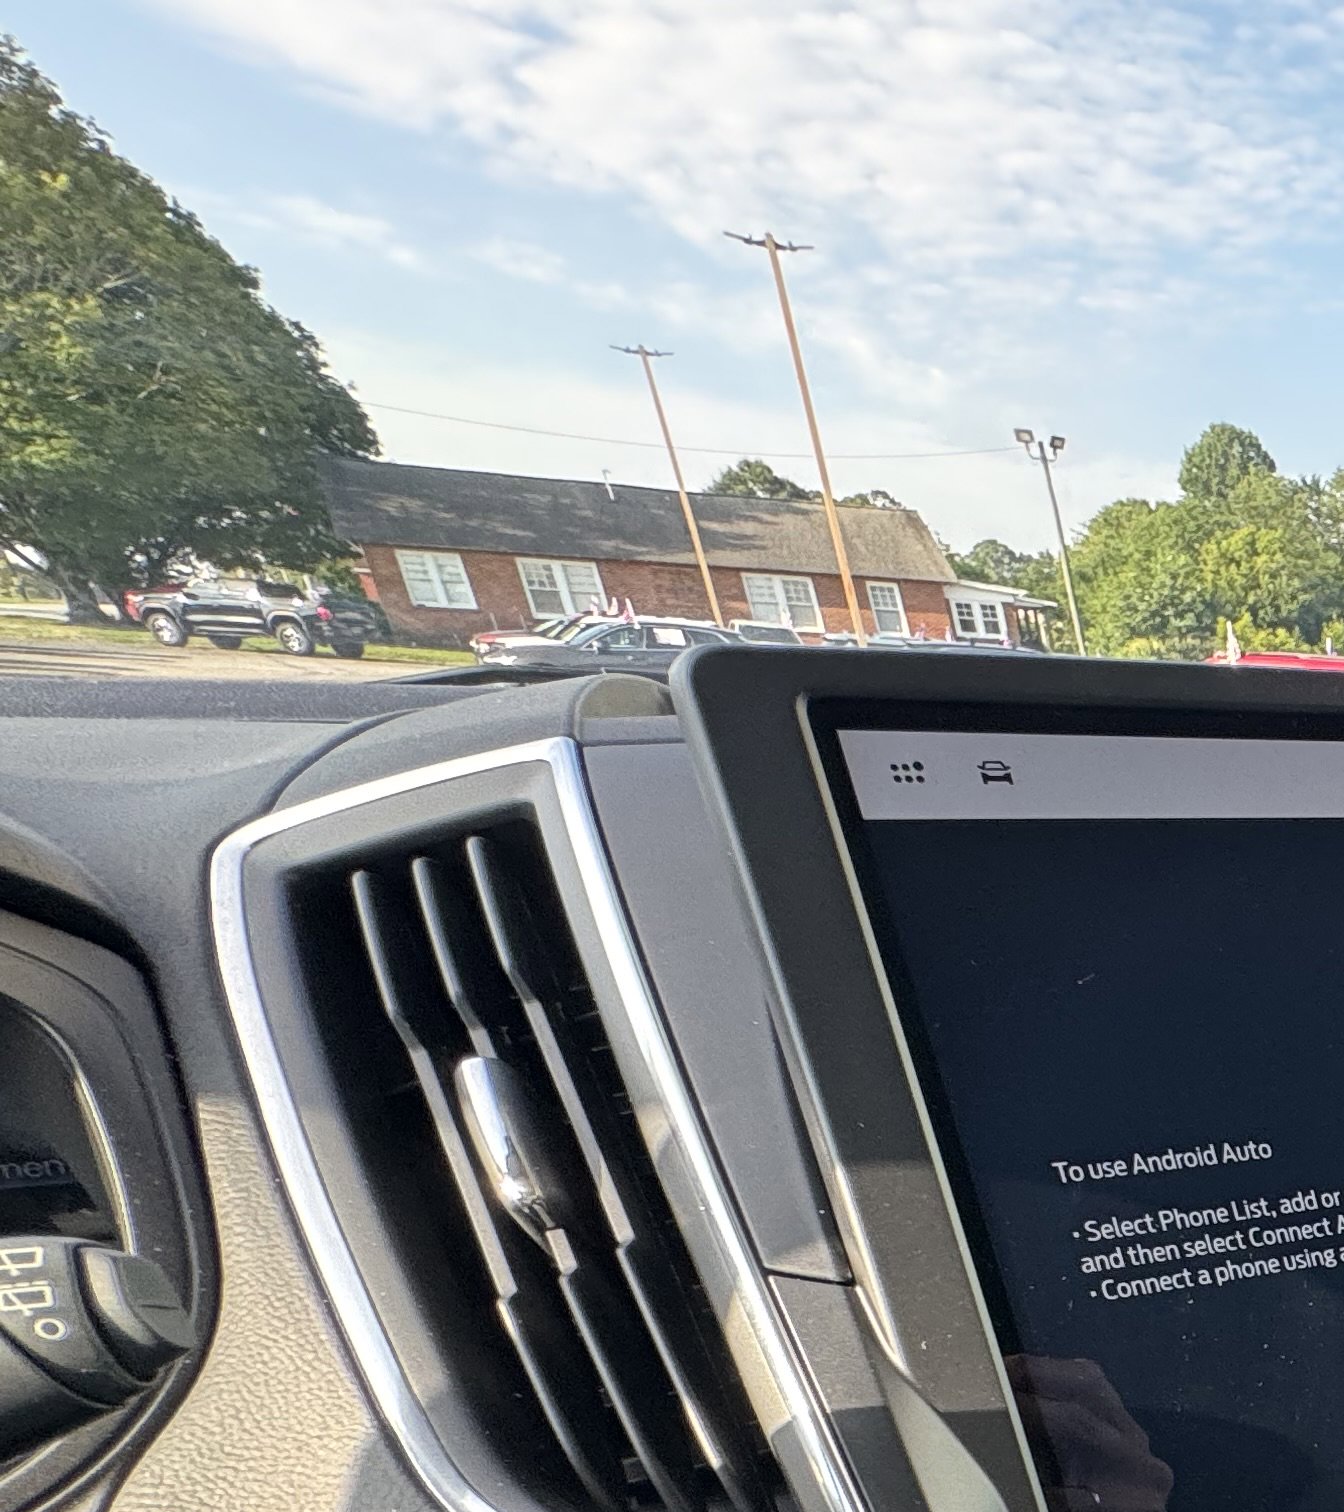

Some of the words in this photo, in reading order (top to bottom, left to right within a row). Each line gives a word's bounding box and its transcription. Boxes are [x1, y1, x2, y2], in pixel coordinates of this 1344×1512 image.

[1051, 1161, 1085, 1184] To
[1088, 1159, 1128, 1181] use
[1133, 1143, 1219, 1176] Android
[1222, 1140, 1273, 1164] Auto
[1083, 1213, 1157, 1242] Select
[1158, 1207, 1230, 1231] Phone
[1230, 1197, 1277, 1221] List,
[1279, 1189, 1319, 1215] add
[1320, 1191, 1340, 1208] or
[1080, 1246, 1126, 1274] and
[1126, 1242, 1181, 1267] then
[1183, 1230, 1247, 1258] select
[1249, 1217, 1333, 1248] Connect
[1101, 1268, 1195, 1300] Connect
[1197, 1269, 1213, 1286] a
[1214, 1257, 1281, 1287] phone
[1283, 1248, 1338, 1272] using
